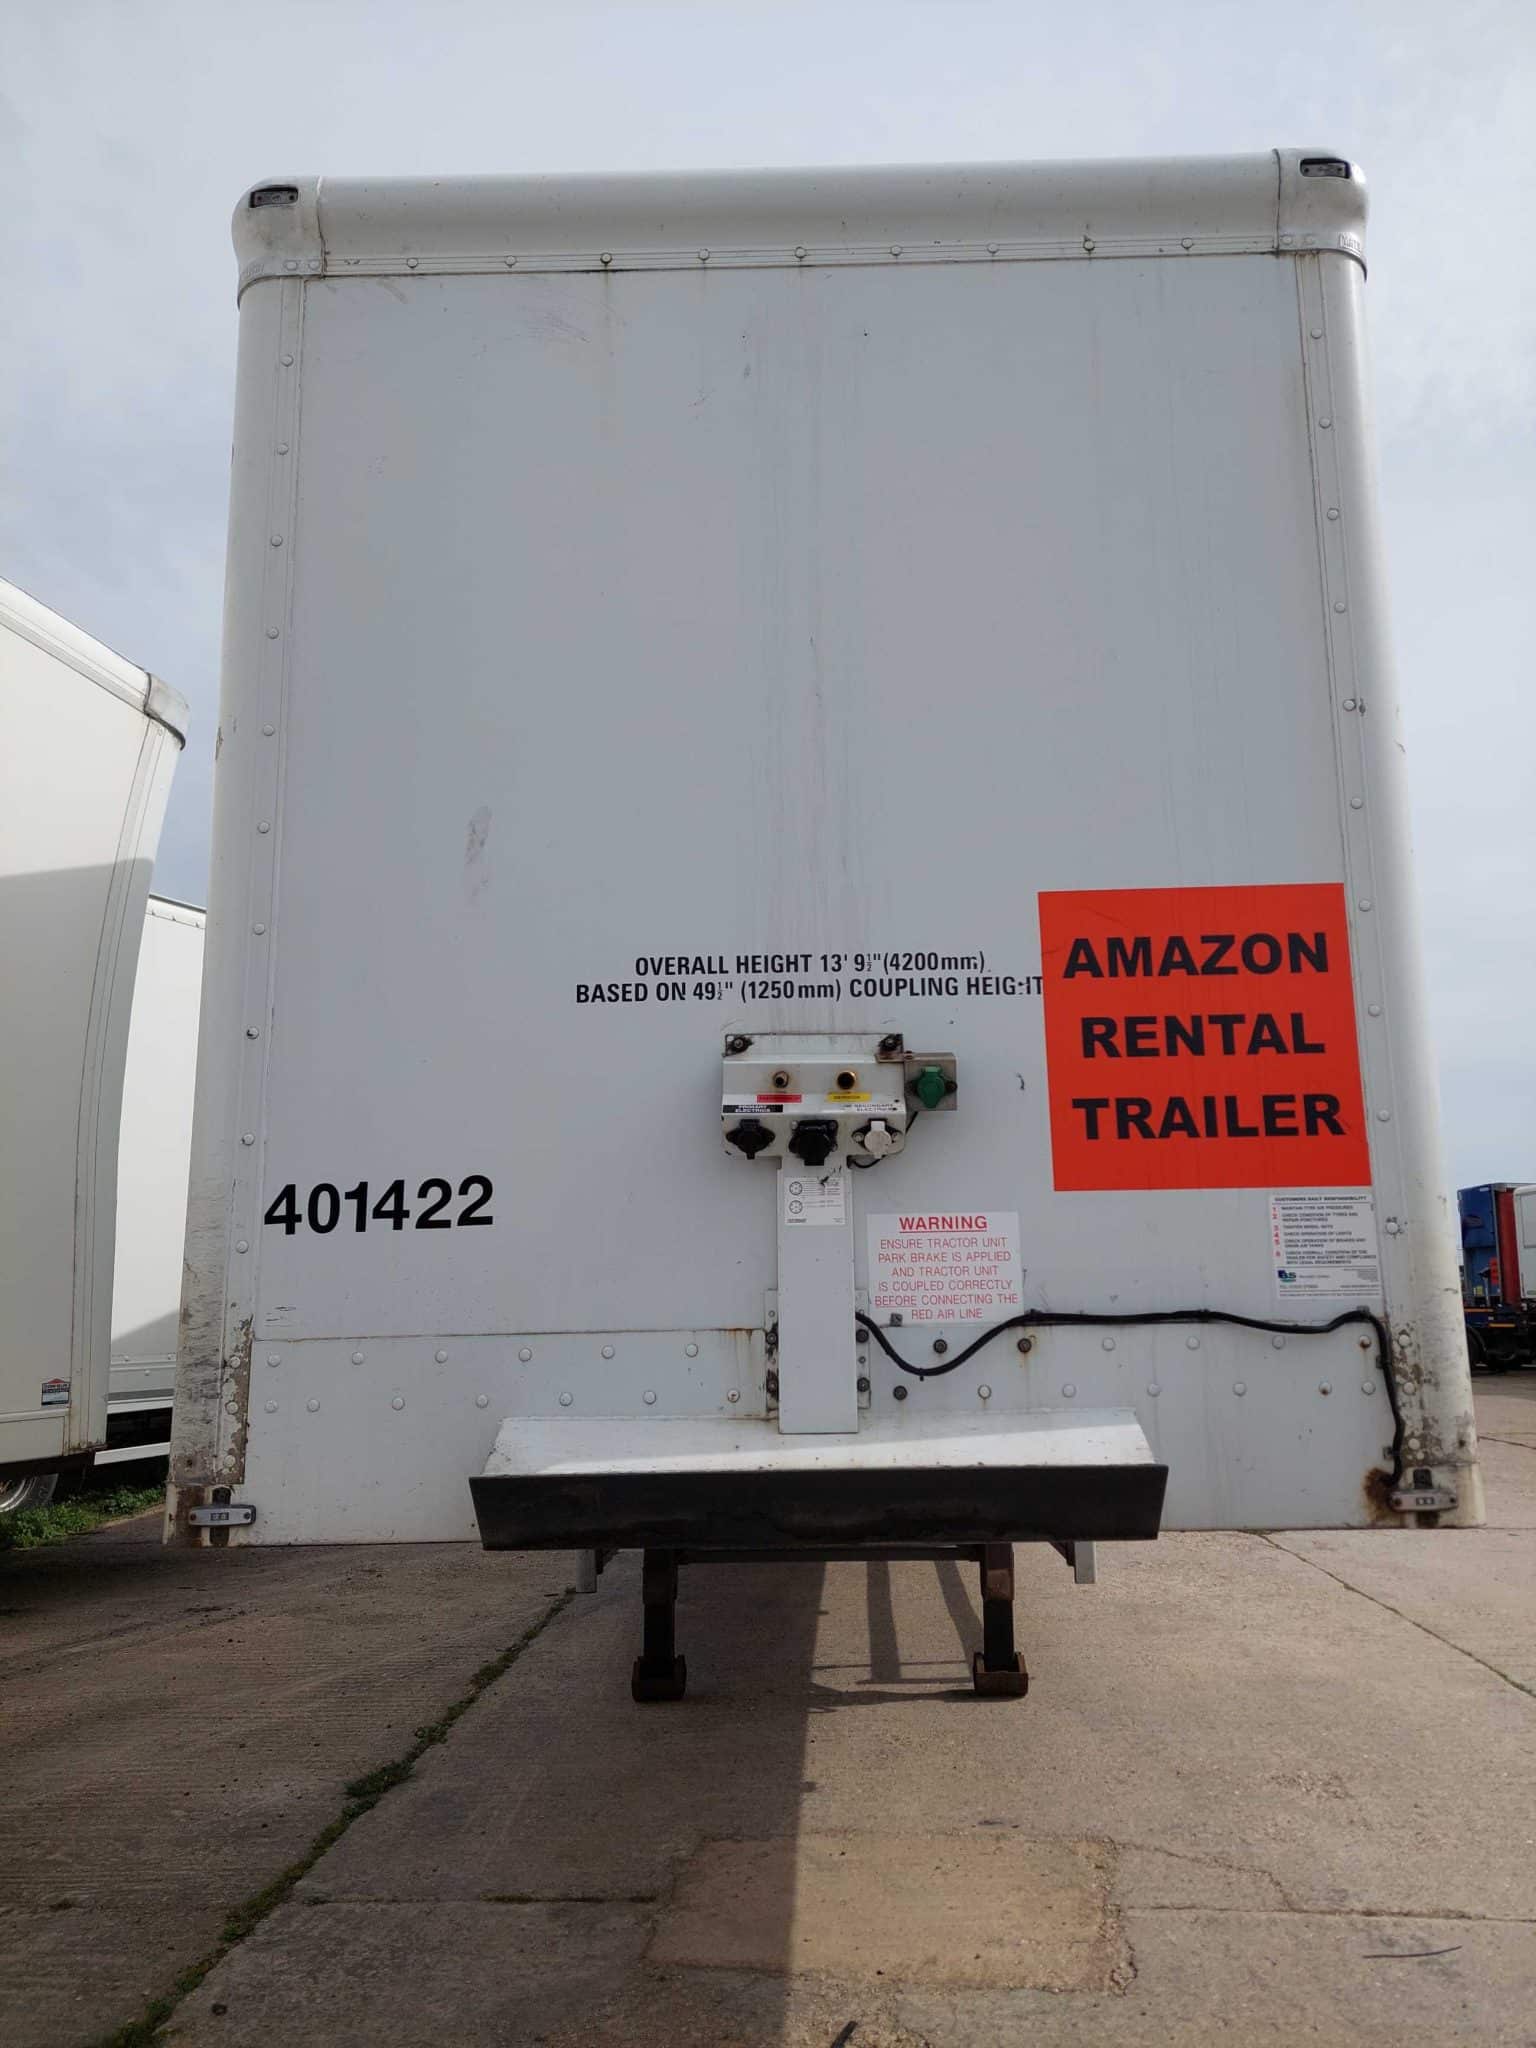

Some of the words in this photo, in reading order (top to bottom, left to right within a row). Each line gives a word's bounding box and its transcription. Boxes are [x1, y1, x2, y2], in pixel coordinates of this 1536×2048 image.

[1063, 932, 1329, 979] AMAZON
[635, 955, 729, 976] OVERALL
[736, 954, 812, 974] HEIGHT
[820, 953, 848, 973] 13'
[576, 983, 649, 1003] BASED
[656, 982, 687, 1001] ON
[849, 977, 959, 997] COUPLING
[1081, 1012, 1326, 1059] RENTAL
[1072, 1093, 1347, 1140] TRAILER
[264, 1174, 494, 1235] 401422
[899, 1215, 988, 1230] WARNING
[880, 1238, 923, 1250] ENSURE
[927, 1237, 978, 1249] TRACTOR
[982, 1236, 1008, 1248] UNIT
[878, 1252, 906, 1264] PARK
[910, 1251, 947, 1263] BRAKE
[952, 1251, 962, 1262] IS
[966, 1250, 1012, 1262] APPLIED
[892, 1266, 915, 1278] AND
[920, 1265, 970, 1277] TRACTOR
[974, 1264, 999, 1276] UNIT
[879, 1281, 889, 1292] IS
[893, 1280, 944, 1292] COUPLED
[948, 1279, 1013, 1291] CORRECTLY
[875, 1295, 917, 1307] BEFORE
[921, 1293, 993, 1305] CONNECTING
[998, 1293, 1019, 1304] THE
[911, 1309, 933, 1321] RED
[937, 1308, 956, 1320] AIR
[959, 1307, 983, 1319] LINE
